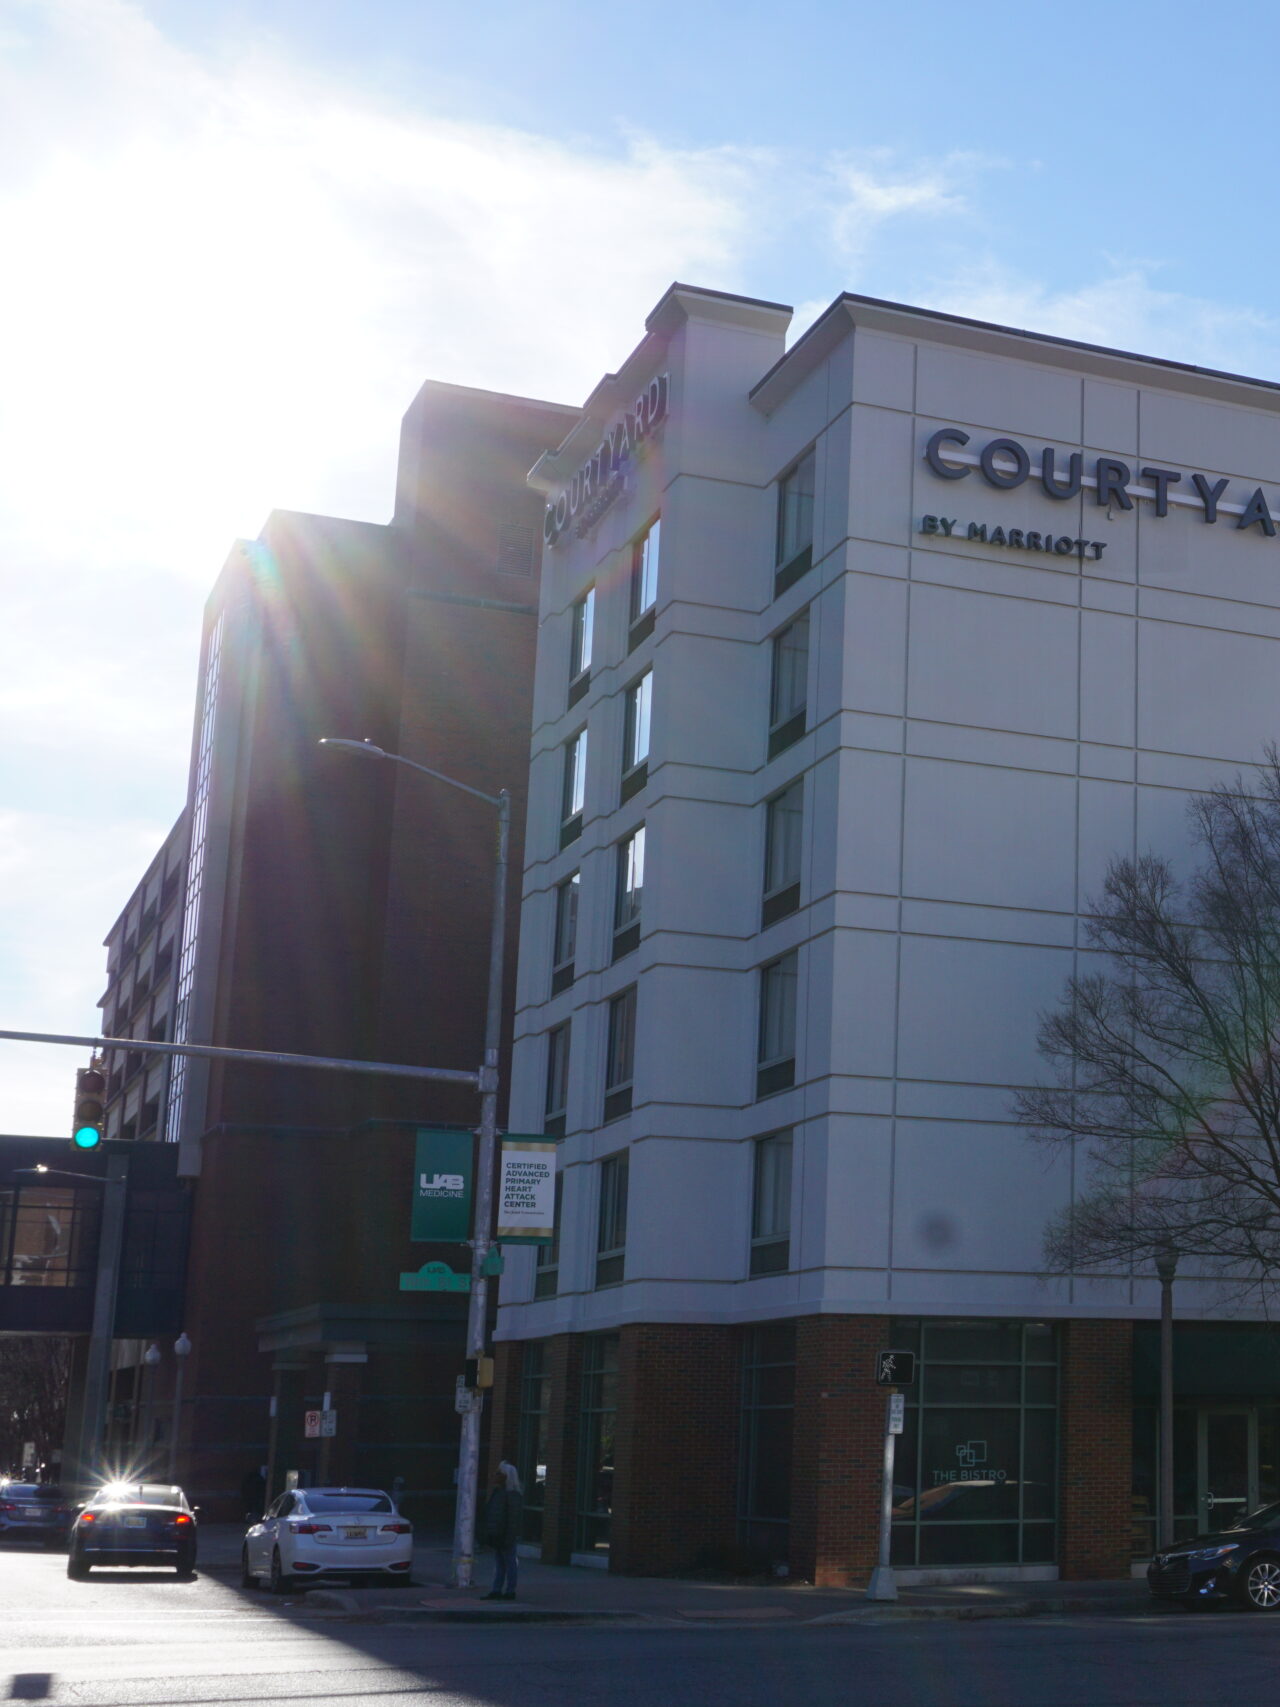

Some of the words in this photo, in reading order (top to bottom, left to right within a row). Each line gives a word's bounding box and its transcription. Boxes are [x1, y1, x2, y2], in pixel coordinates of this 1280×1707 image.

[919, 514, 957, 537] BY
[967, 522, 1107, 561] MARRIOTT
[506, 1162, 547, 1170] CERTIFIED
[505, 1170, 550, 1178] ADVANCED
[420, 1173, 464, 1189] UAB
[419, 1189, 464, 1199] MEDICINE
[504, 1193, 536, 1201] ATTACK
[504, 1201, 537, 1209] CENTER
[932, 1470, 957, 1481] THE
[960, 1470, 1007, 1481] BISTRO
